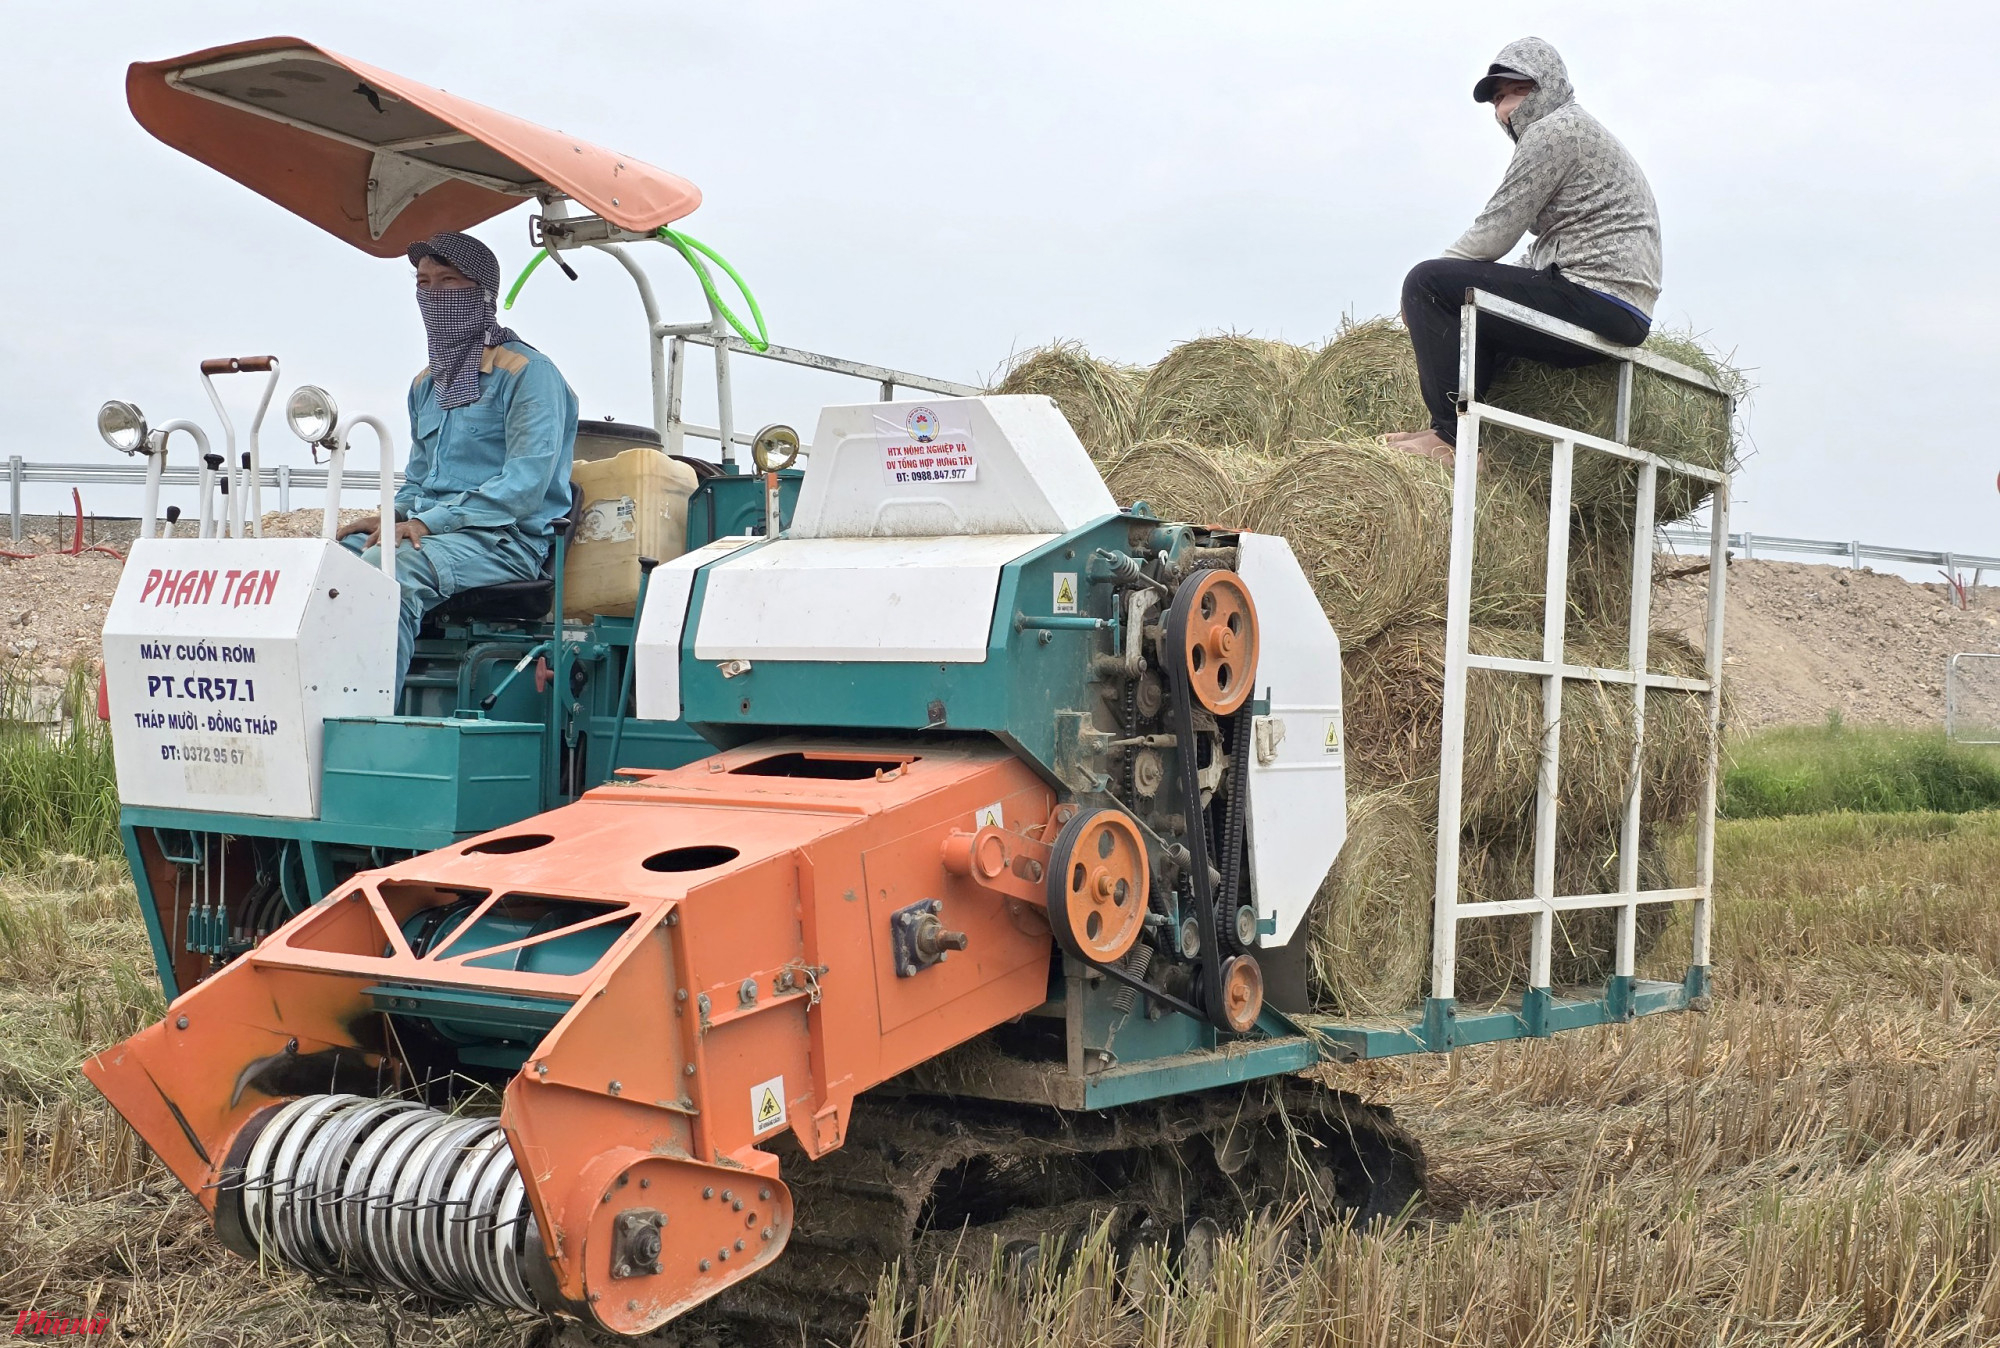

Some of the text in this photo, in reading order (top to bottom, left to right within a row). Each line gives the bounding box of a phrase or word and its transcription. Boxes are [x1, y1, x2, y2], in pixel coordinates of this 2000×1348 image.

[887, 441, 967, 456] HTX NÔNG NGHIỆP VÀ
[886, 460, 896, 470] DV
[898, 457, 918, 469] TỔNG
[919, 458, 934, 470] HỢP
[959, 455, 973, 466] TÂY
[896, 469, 967, 482] ĐT: 0988.847.977
[140, 569, 280, 608] PHAN TAN
[140, 639, 256, 663] MÁY CUỐN RƠM
[134, 709, 165, 729] THÁP
[168, 710, 198, 730] MƯỜI
[207, 709, 242, 733] ĐỒNG
[245, 714, 278, 735] THÁP
[161, 744, 245, 765] ĐT: 0372 95 67
